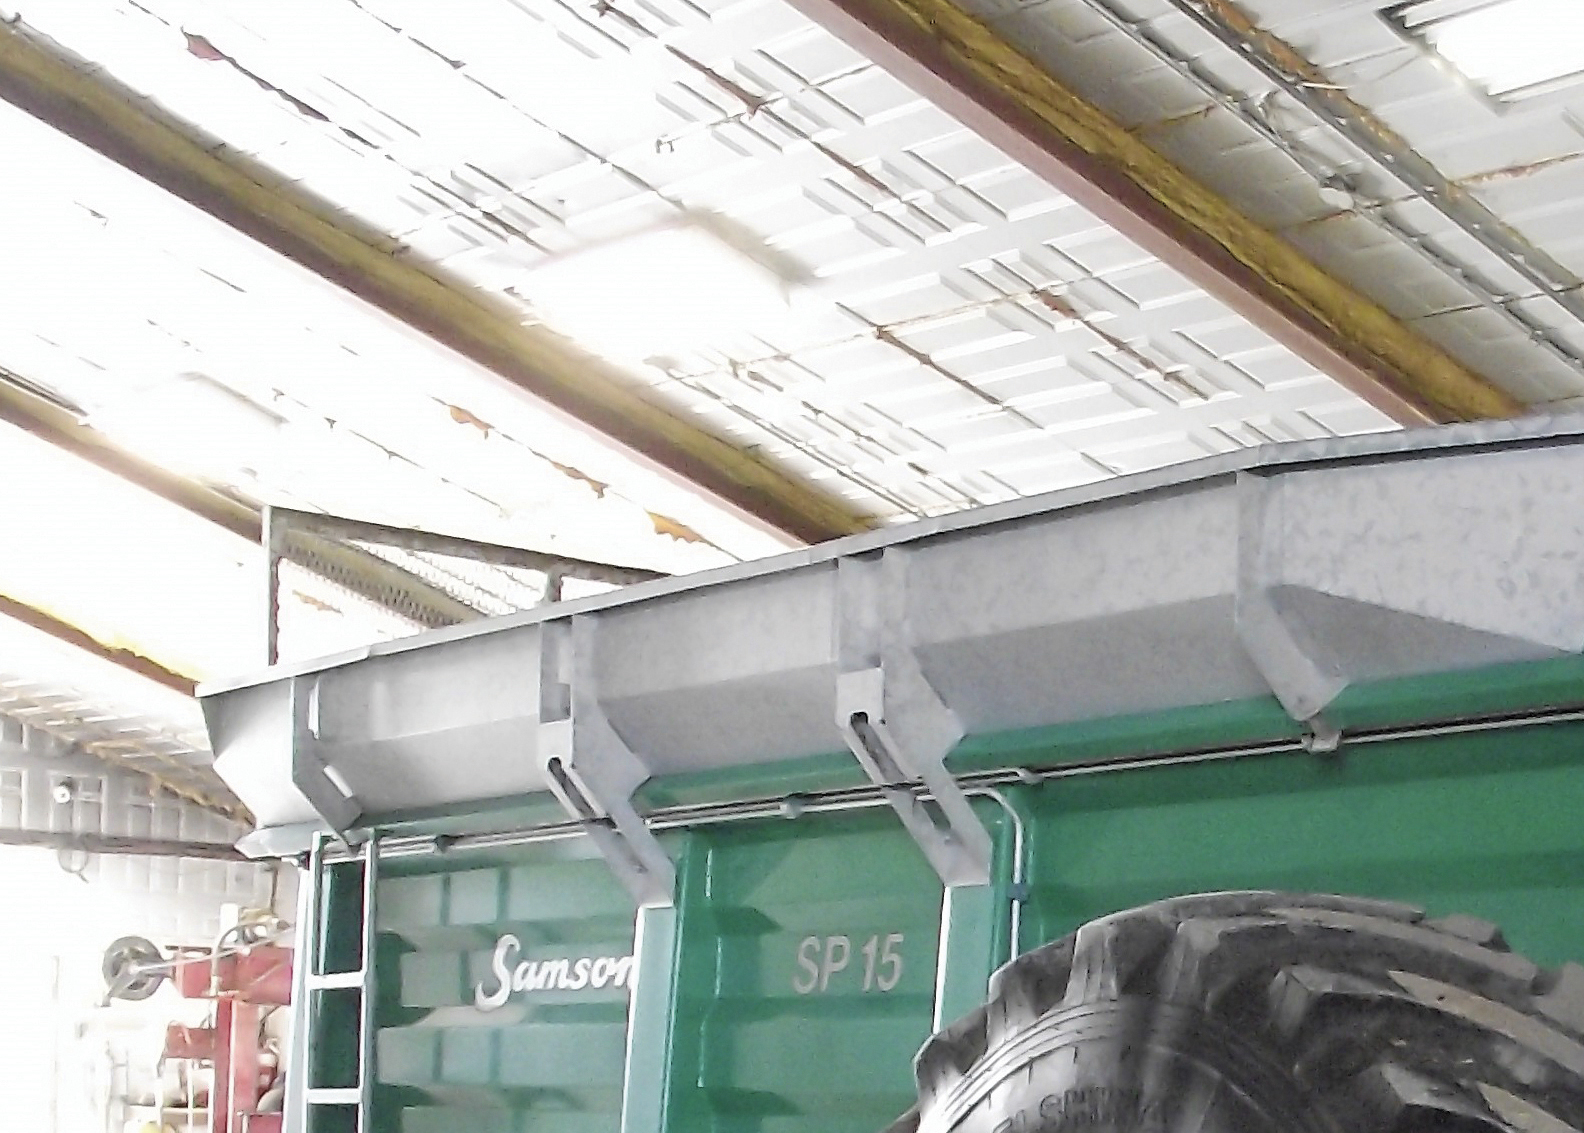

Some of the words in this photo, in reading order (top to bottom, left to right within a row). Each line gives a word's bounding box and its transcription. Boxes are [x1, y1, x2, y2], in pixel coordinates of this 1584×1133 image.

[475, 933, 635, 1012] Samson
[793, 935, 850, 994] SP
[862, 933, 904, 992] 15
